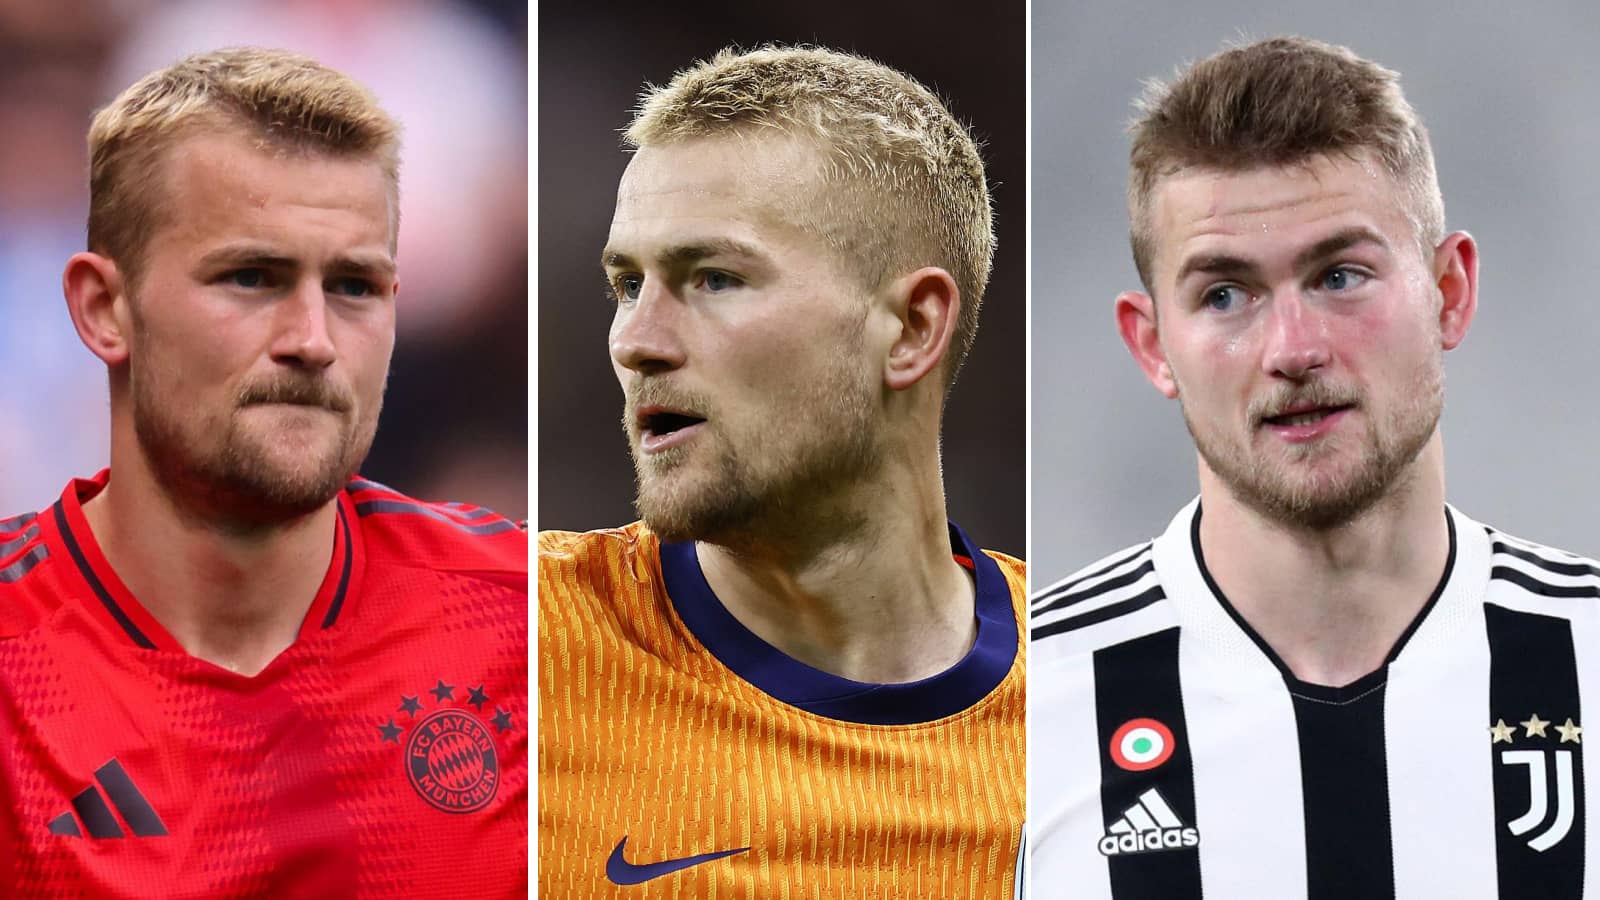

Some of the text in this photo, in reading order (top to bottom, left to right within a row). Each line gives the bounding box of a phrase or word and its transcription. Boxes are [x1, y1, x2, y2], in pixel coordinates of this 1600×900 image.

[412, 716, 491, 758] FC BAYERN
[1100, 826, 1199, 855] adidas
